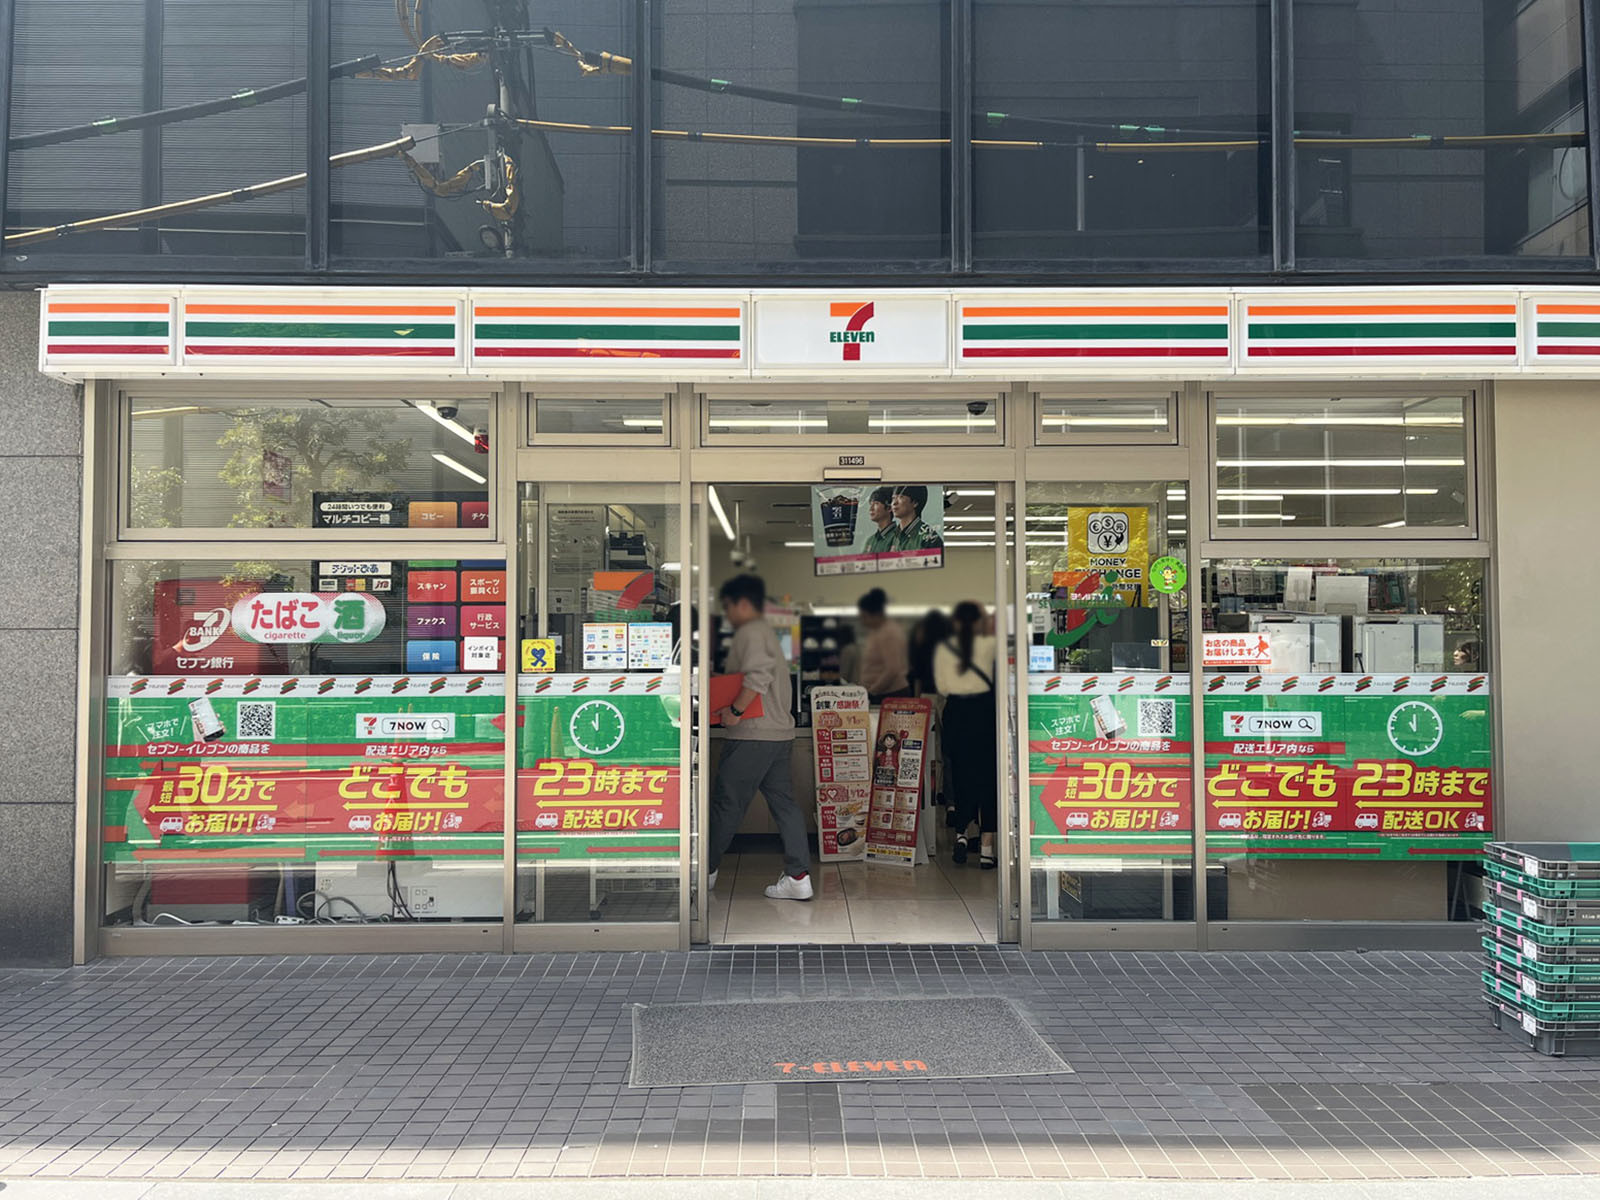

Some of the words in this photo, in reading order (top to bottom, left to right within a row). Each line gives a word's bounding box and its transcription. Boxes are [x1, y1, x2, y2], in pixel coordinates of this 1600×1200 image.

[830, 301, 874, 360] 7
[322, 513, 390, 524] マルチコピー機
[421, 512, 444, 520] コピー
[1090, 558, 1126, 566] MONEY
[251, 599, 320, 630] たばこ
[334, 599, 365, 630] 酒
[477, 613, 493, 621] 行政
[417, 617, 446, 625] ファクス
[189, 626, 221, 636] BANK
[264, 631, 306, 640] cigarette
[336, 631, 364, 640] liquor
[1206, 639, 1246, 647] お店の商品
[176, 657, 234, 669] セブン銀行
[389, 722, 426, 730] 7NOW
[1051, 715, 1081, 727] スマホで
[1256, 720, 1293, 729] 7NOW
[365, 745, 447, 756] 配送エリア内なら
[1233, 743, 1315, 754] 配送エリア内なら
[338, 765, 468, 798] どこでも
[533, 762, 669, 796] 23時まで
[1207, 764, 1337, 798] どこでも
[1352, 763, 1488, 797] 23時まで
[562, 809, 639, 829] 配送OK
[1382, 810, 1460, 830] 配送OK
